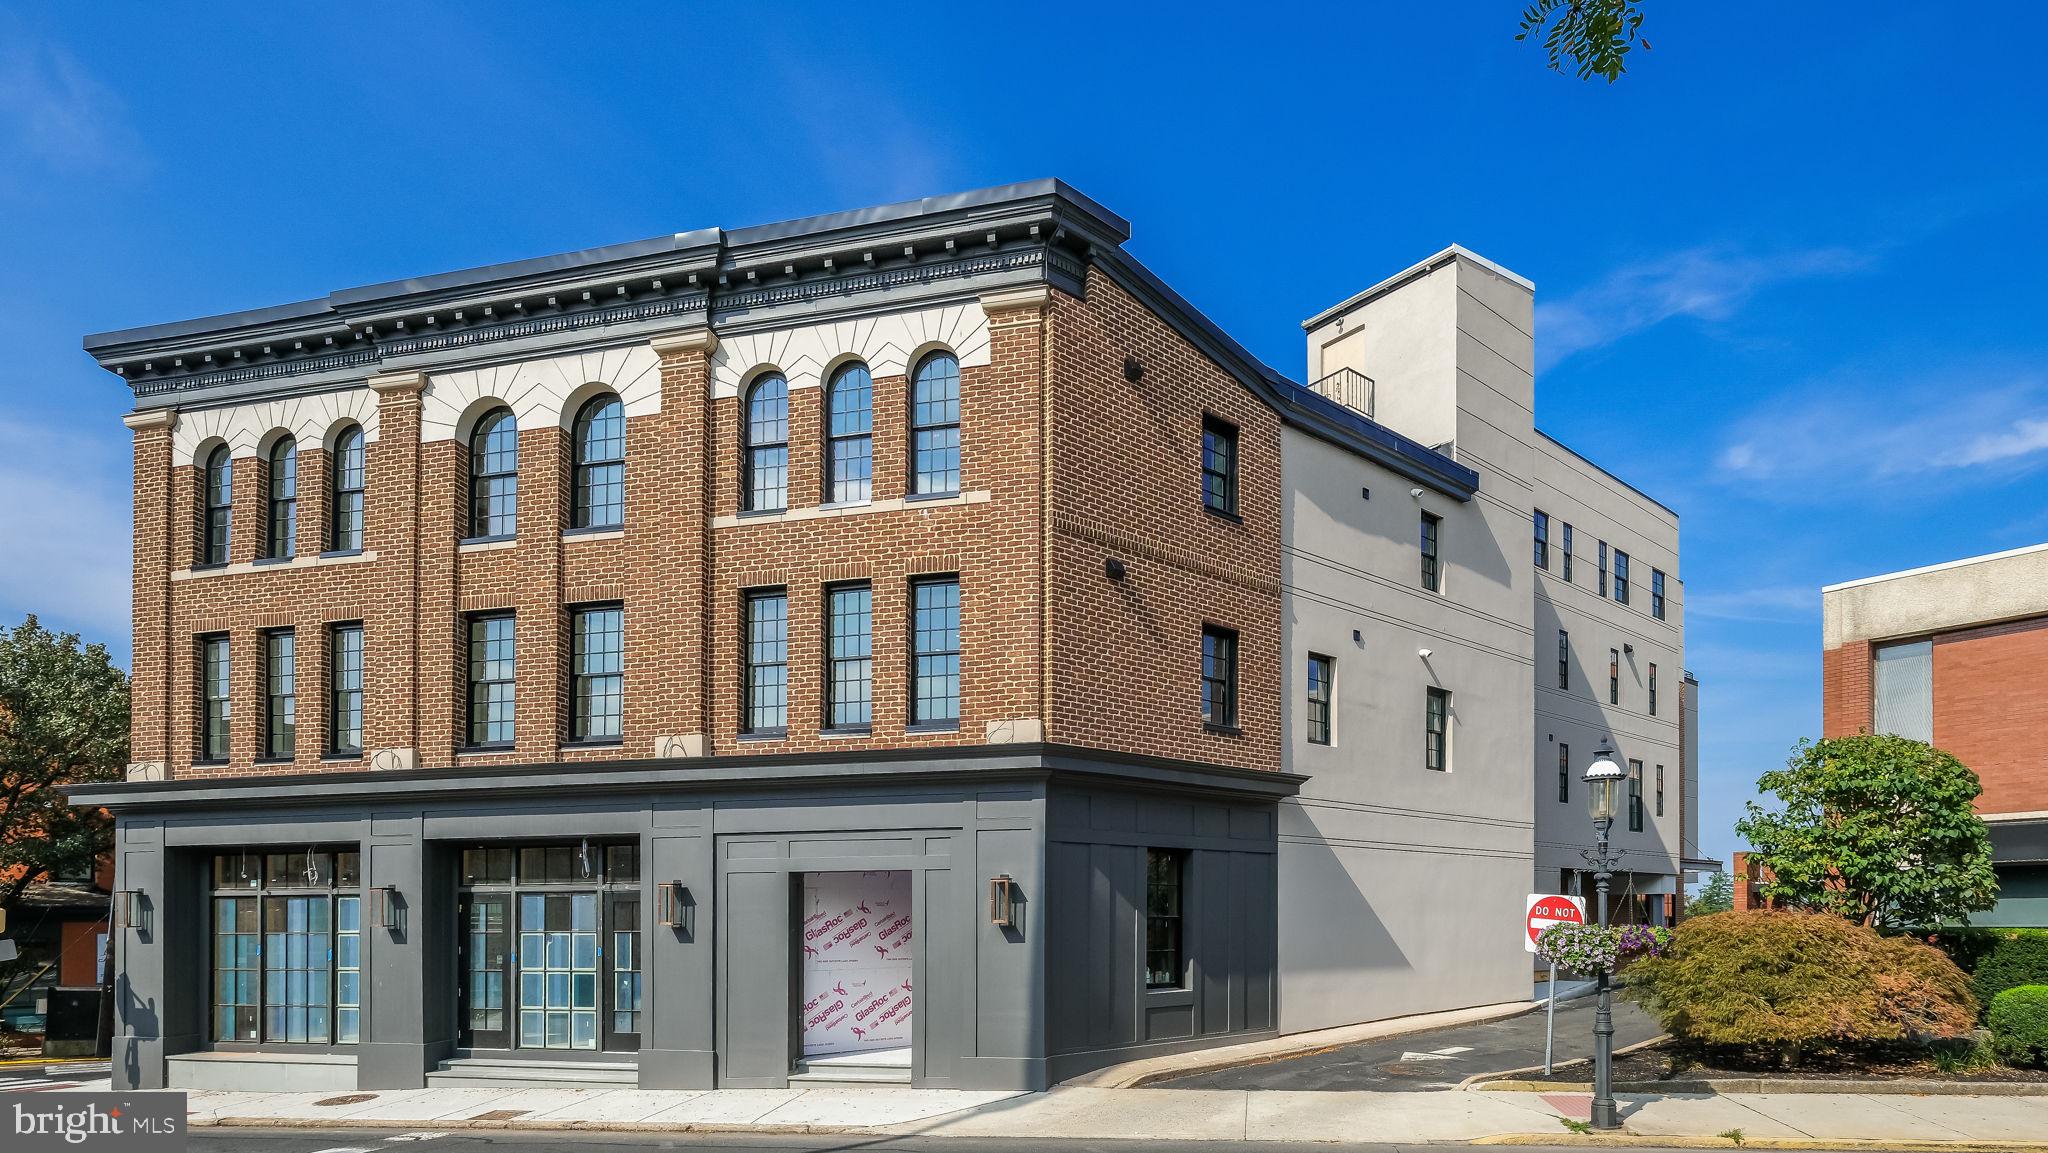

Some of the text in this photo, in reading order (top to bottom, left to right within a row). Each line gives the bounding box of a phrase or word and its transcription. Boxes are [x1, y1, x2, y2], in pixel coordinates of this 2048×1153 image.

[1535, 905, 1576, 918] DO NOT
[833, 918, 868, 944] GlasRoc
[879, 915, 911, 941] GlasRoc
[808, 999, 844, 1028] GlasRoc
[855, 994, 889, 1022] GlasRoc
[879, 995, 912, 1023] GlasRoc
